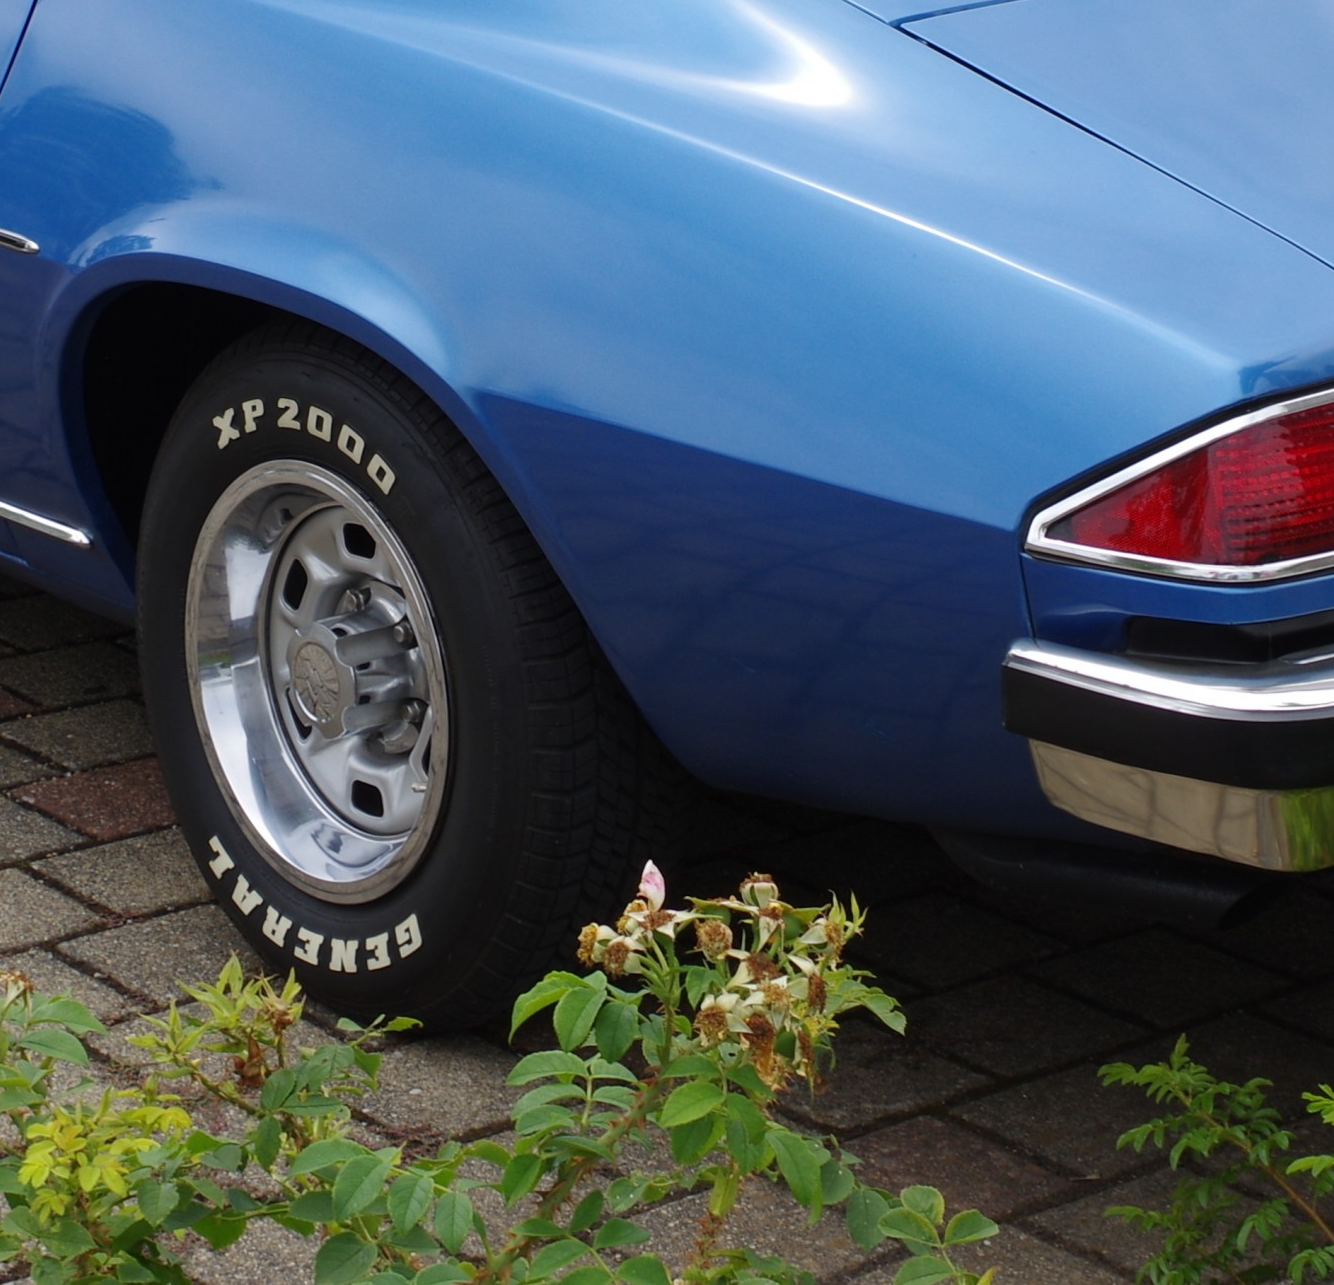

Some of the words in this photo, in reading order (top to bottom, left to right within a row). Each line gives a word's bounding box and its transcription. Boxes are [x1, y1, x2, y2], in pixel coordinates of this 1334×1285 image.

[212, 398, 265, 450] XP
[277, 397, 396, 496] 2000
[208, 835, 422, 973] GENERAL
